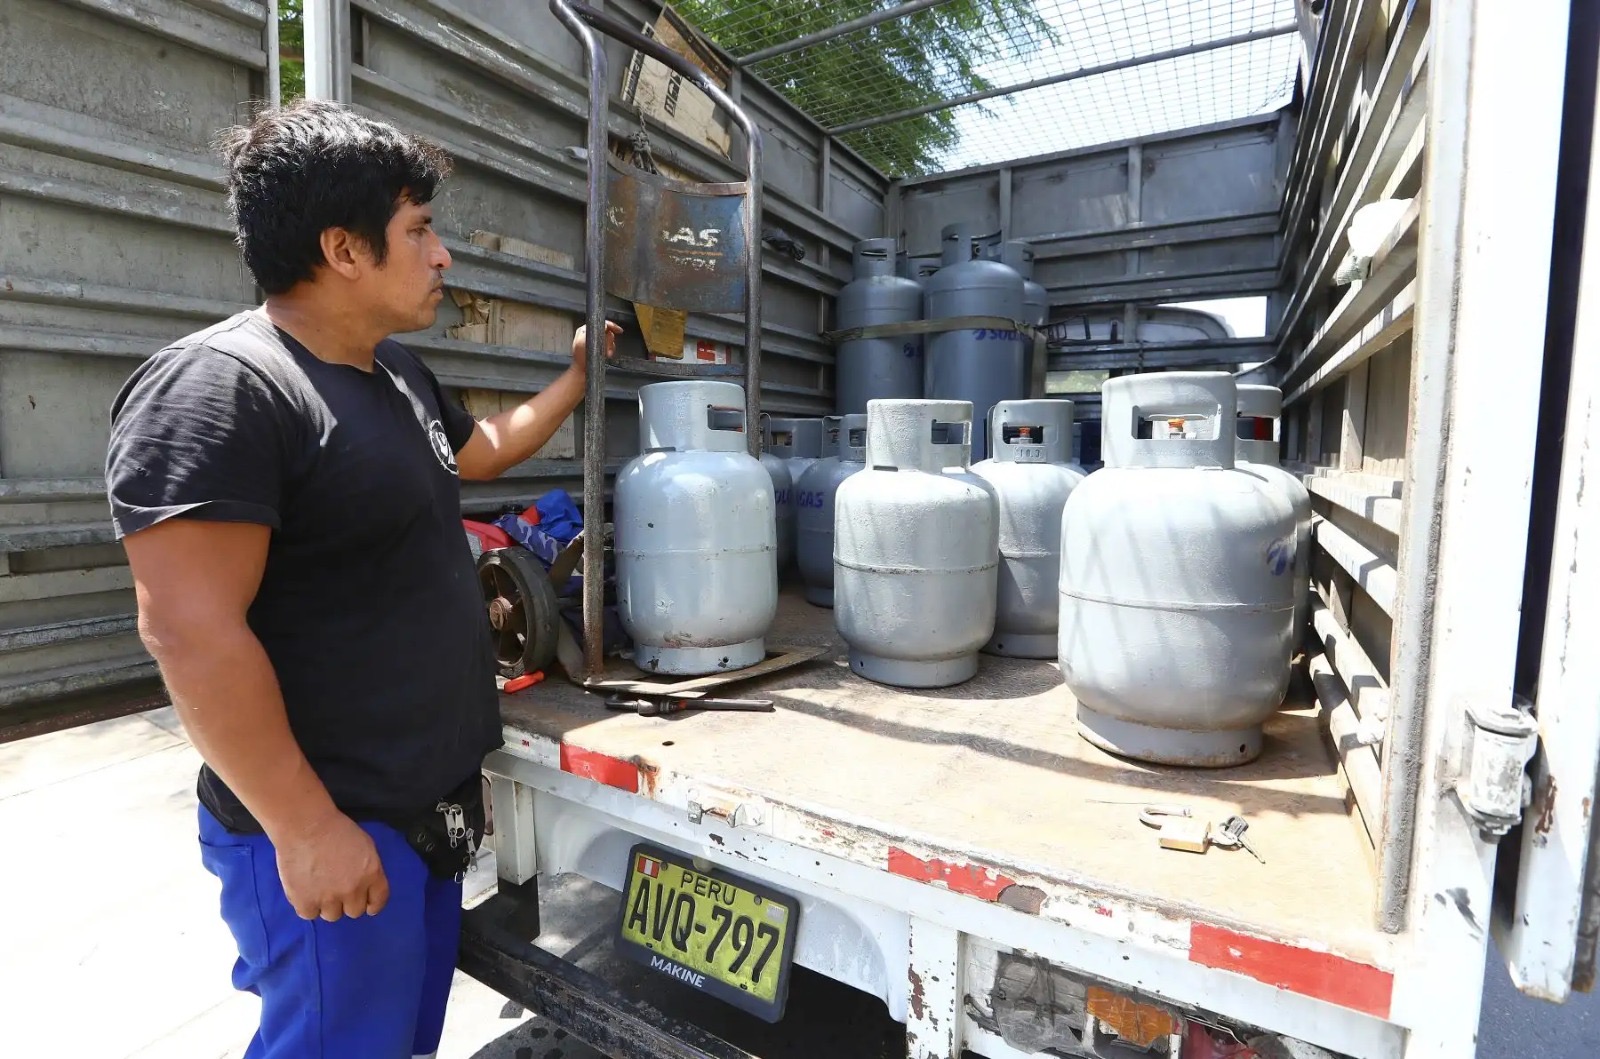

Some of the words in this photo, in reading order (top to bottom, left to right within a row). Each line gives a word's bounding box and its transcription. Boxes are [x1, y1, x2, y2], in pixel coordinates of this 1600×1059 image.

[680, 870, 738, 906] PERU
[1095, 906, 1112, 918] 3M
[628, 878, 780, 984] AVQ-797
[650, 955, 706, 988] MAKINE
